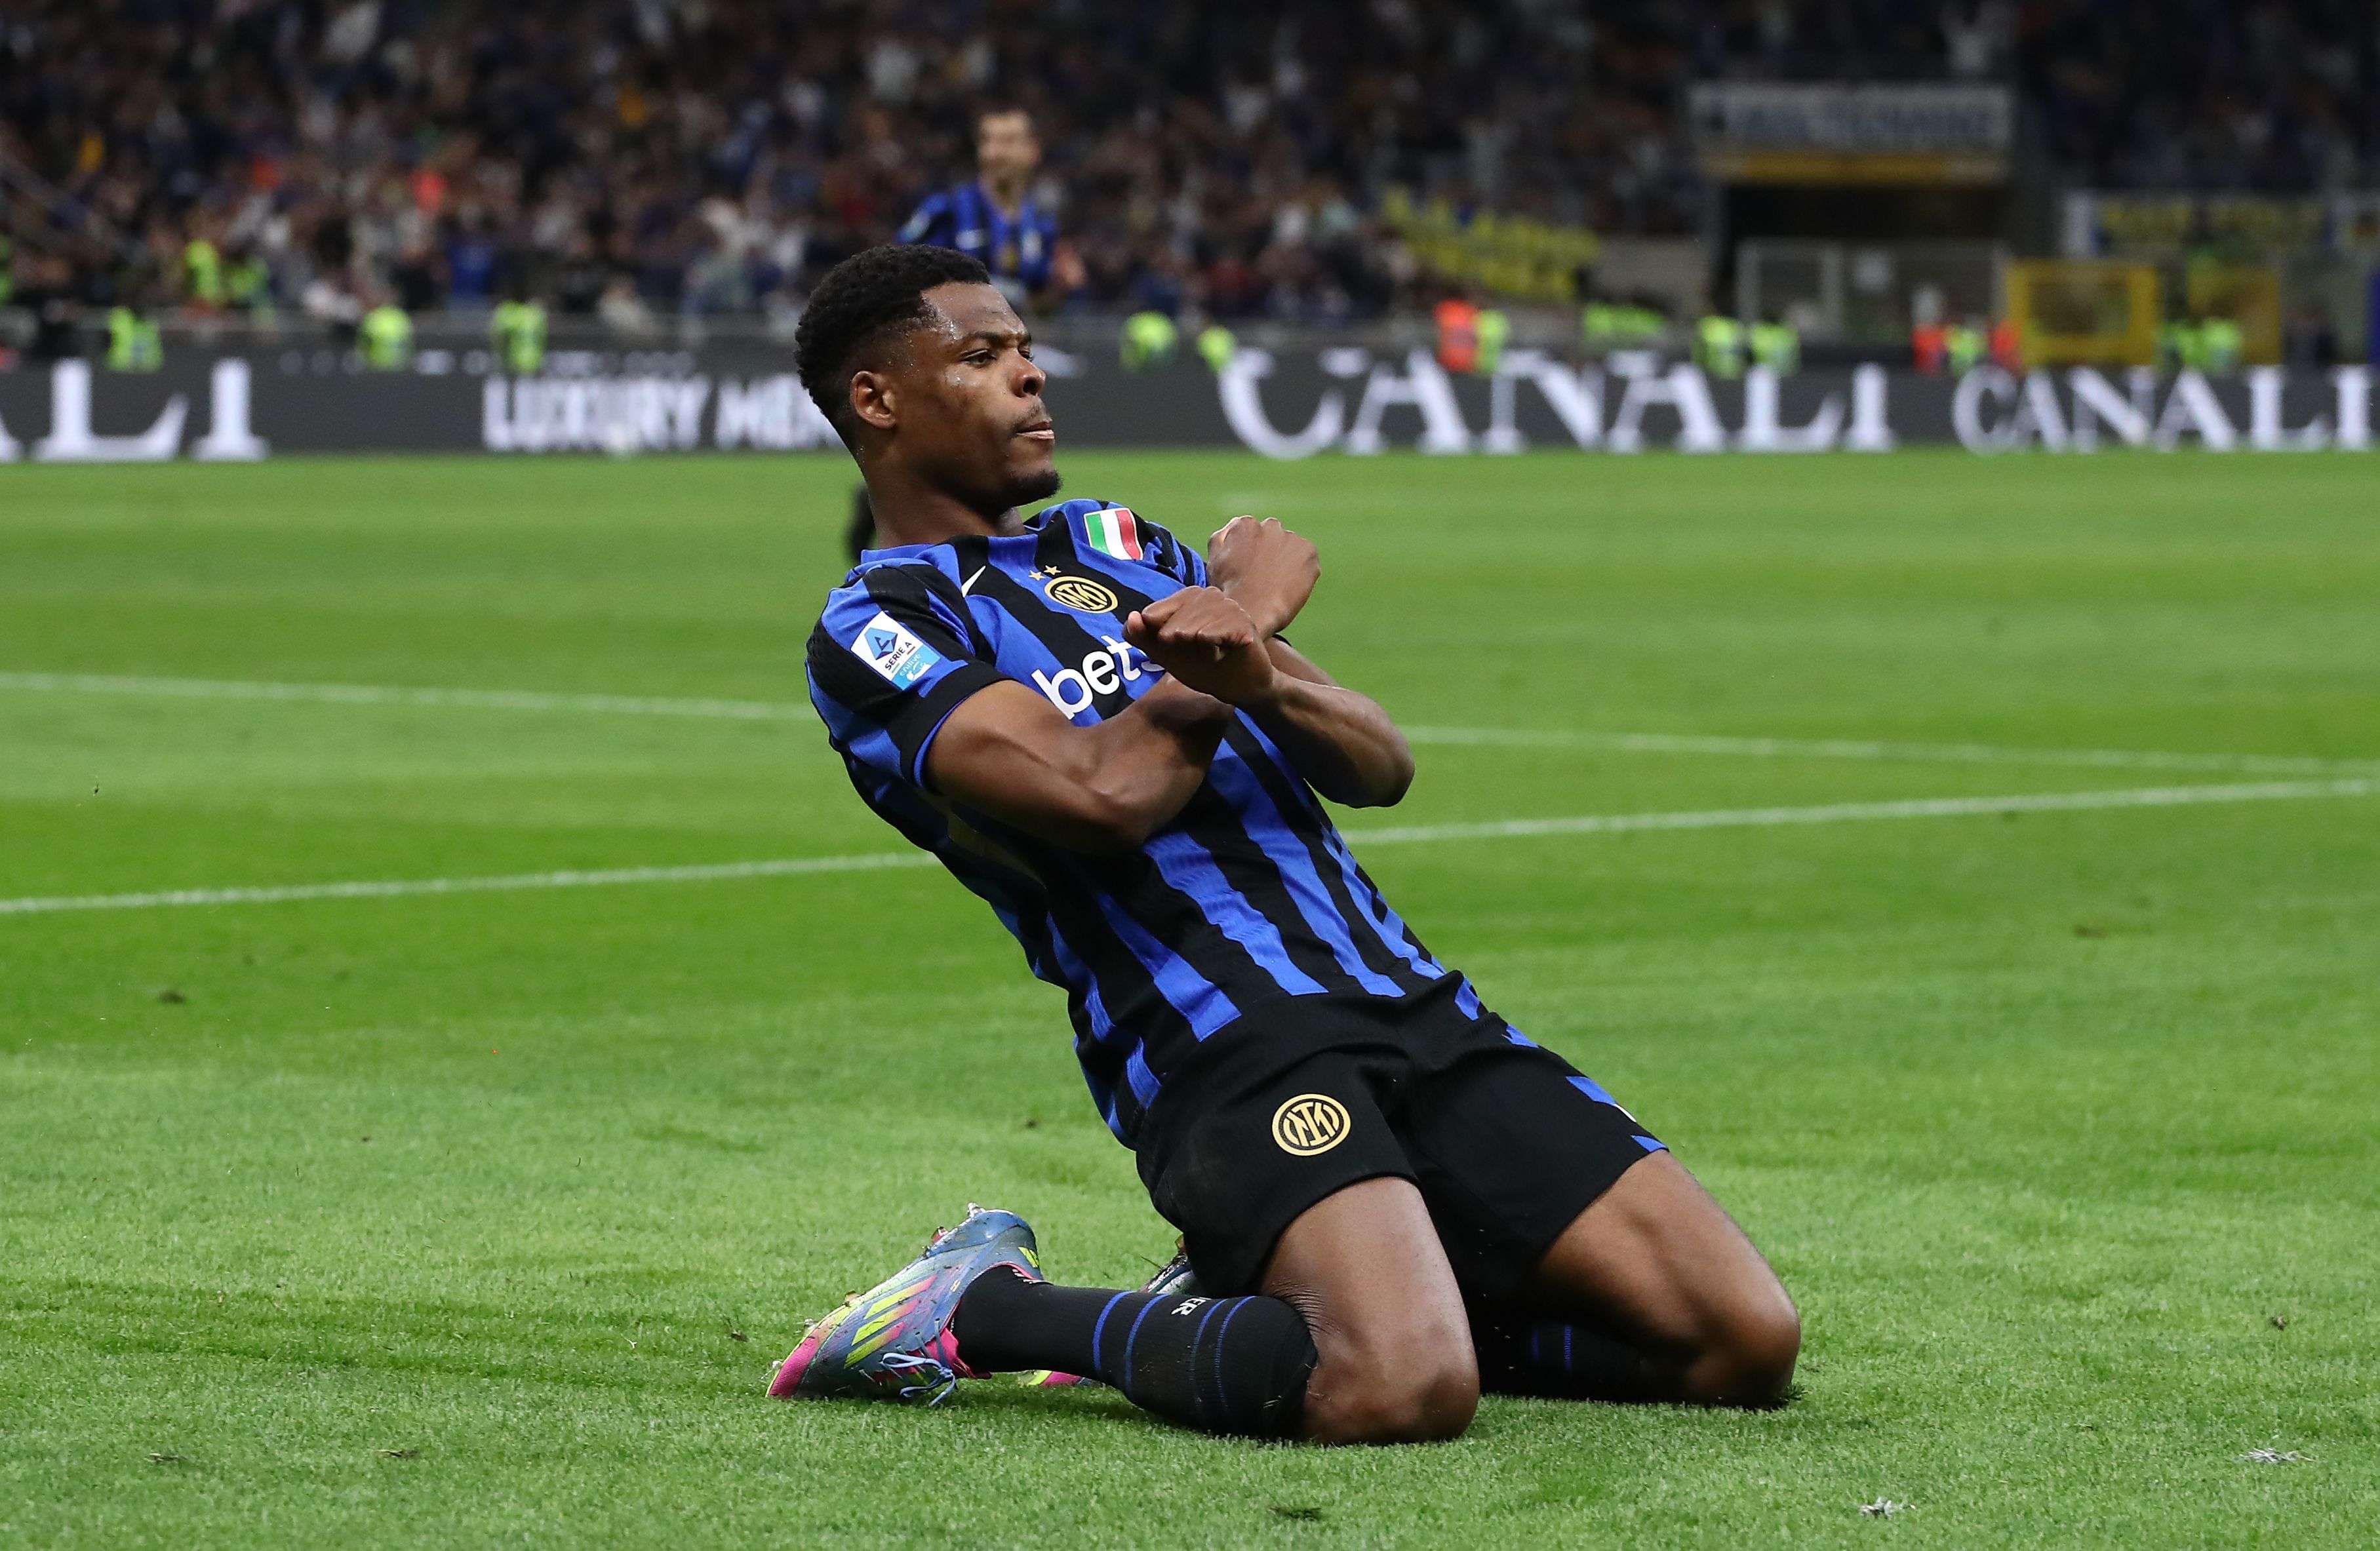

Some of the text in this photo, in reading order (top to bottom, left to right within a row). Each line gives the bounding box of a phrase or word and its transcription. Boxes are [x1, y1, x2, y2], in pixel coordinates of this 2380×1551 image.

[0, 357, 270, 461] LI
[1217, 346, 1895, 459] CANALI
[1951, 364, 2370, 455] CANALI
[885, 648, 905, 670] SERIE
